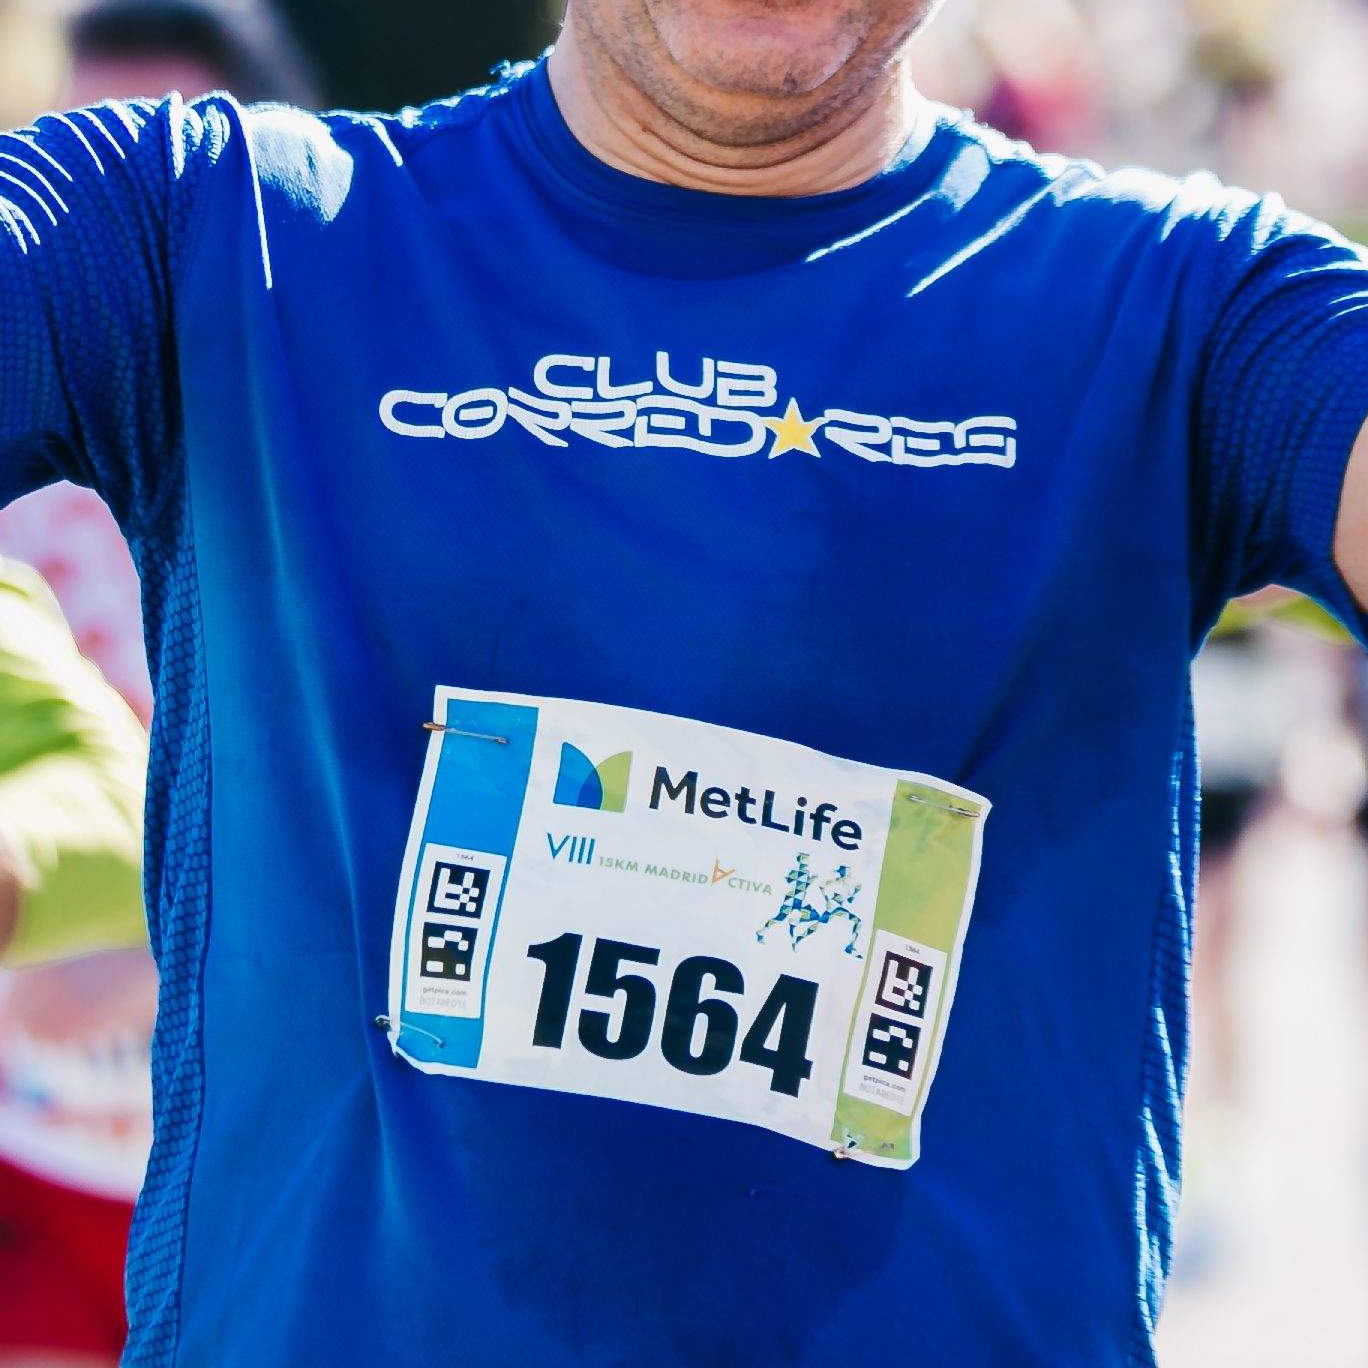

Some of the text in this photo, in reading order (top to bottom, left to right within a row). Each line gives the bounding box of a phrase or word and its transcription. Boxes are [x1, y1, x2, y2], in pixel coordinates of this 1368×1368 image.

[533, 350, 779, 408] CLUB
[648, 765, 864, 852] MetLife
[546, 832, 597, 865] VIII
[598, 855, 639, 873] 15KM
[644, 863, 709, 885] MADRID
[526, 930, 820, 1099] 1564
